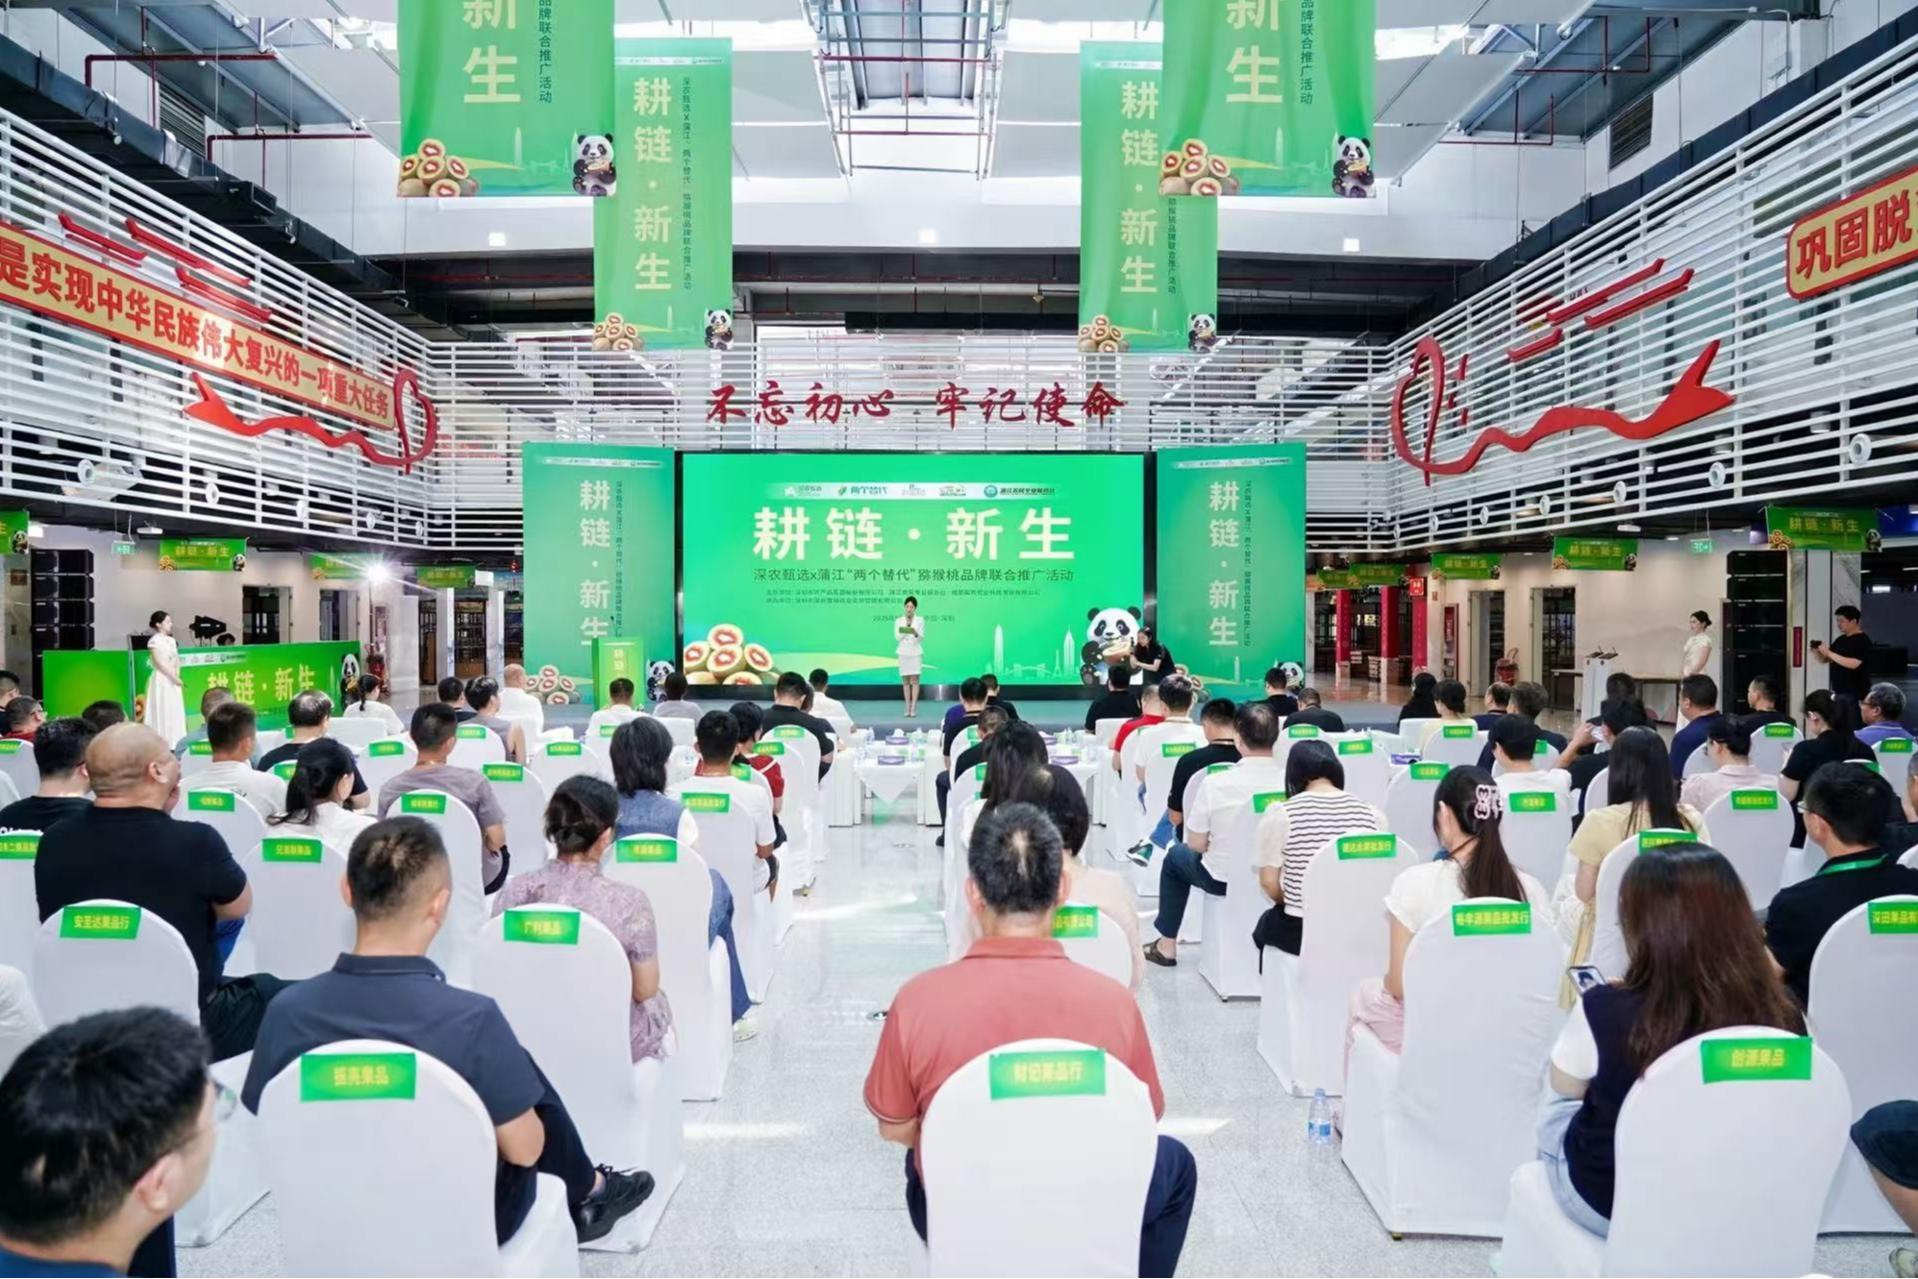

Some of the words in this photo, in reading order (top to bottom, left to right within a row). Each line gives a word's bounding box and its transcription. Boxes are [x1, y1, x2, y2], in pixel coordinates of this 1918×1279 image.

[634, 77, 672, 290] 耕链·新生
[1121, 81, 1159, 293] 耕链·新生
[1796, 188, 1918, 279] 巩固脱
[0, 241, 390, 419] 是实现中华民族伟大复兴的一项重大任务
[707, 380, 894, 426] 不忘初心
[935, 381, 1126, 429] 牢记使命
[753, 506, 1075, 560] 耕链·新生
[1209, 481, 1240, 646] 耕链·新生
